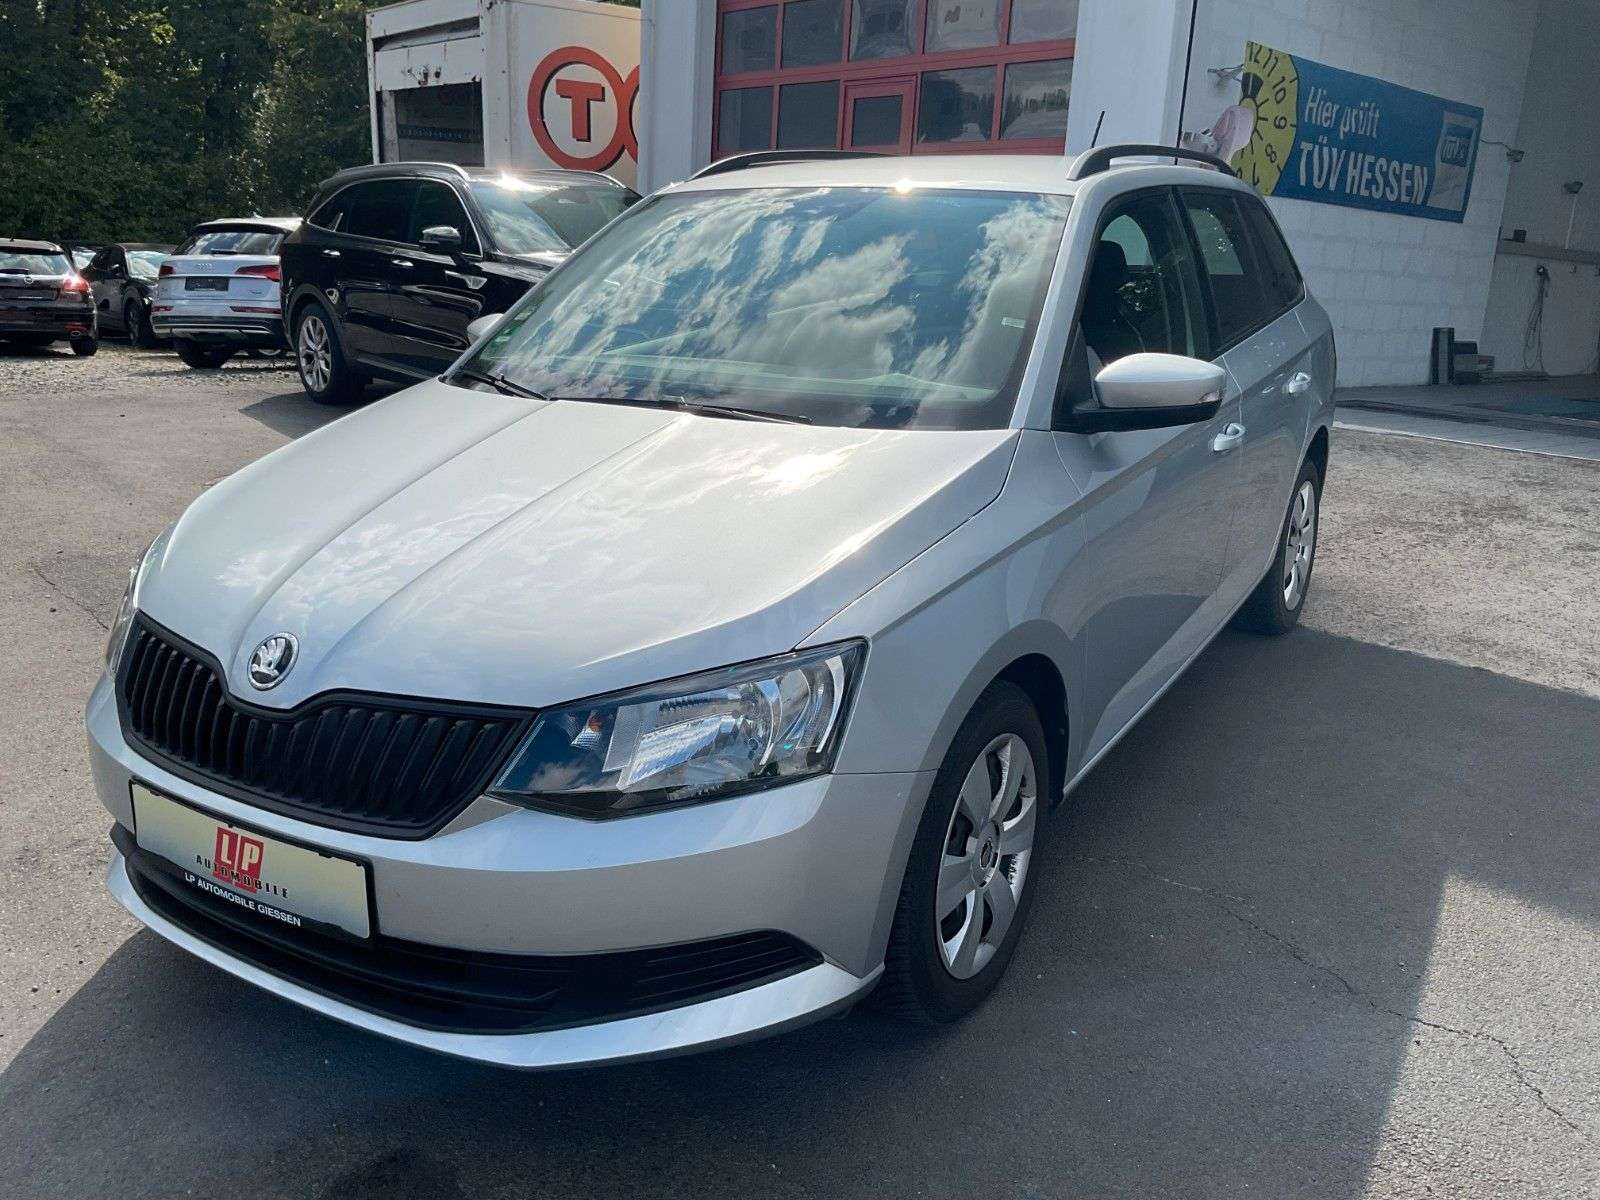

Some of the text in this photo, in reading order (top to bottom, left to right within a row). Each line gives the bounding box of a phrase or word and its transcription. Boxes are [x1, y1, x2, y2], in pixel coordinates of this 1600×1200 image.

[1271, 75, 1287, 105] 10
[1304, 86, 1380, 139] Hier prüft
[1264, 143, 1278, 164] 8
[1299, 135, 1429, 205] TÜV HESSEN
[220, 833, 261, 871] LP
[196, 854, 289, 899] AUTOMOBILE
[184, 872, 302, 927] LP AUTOMOBILE GIESSEN
